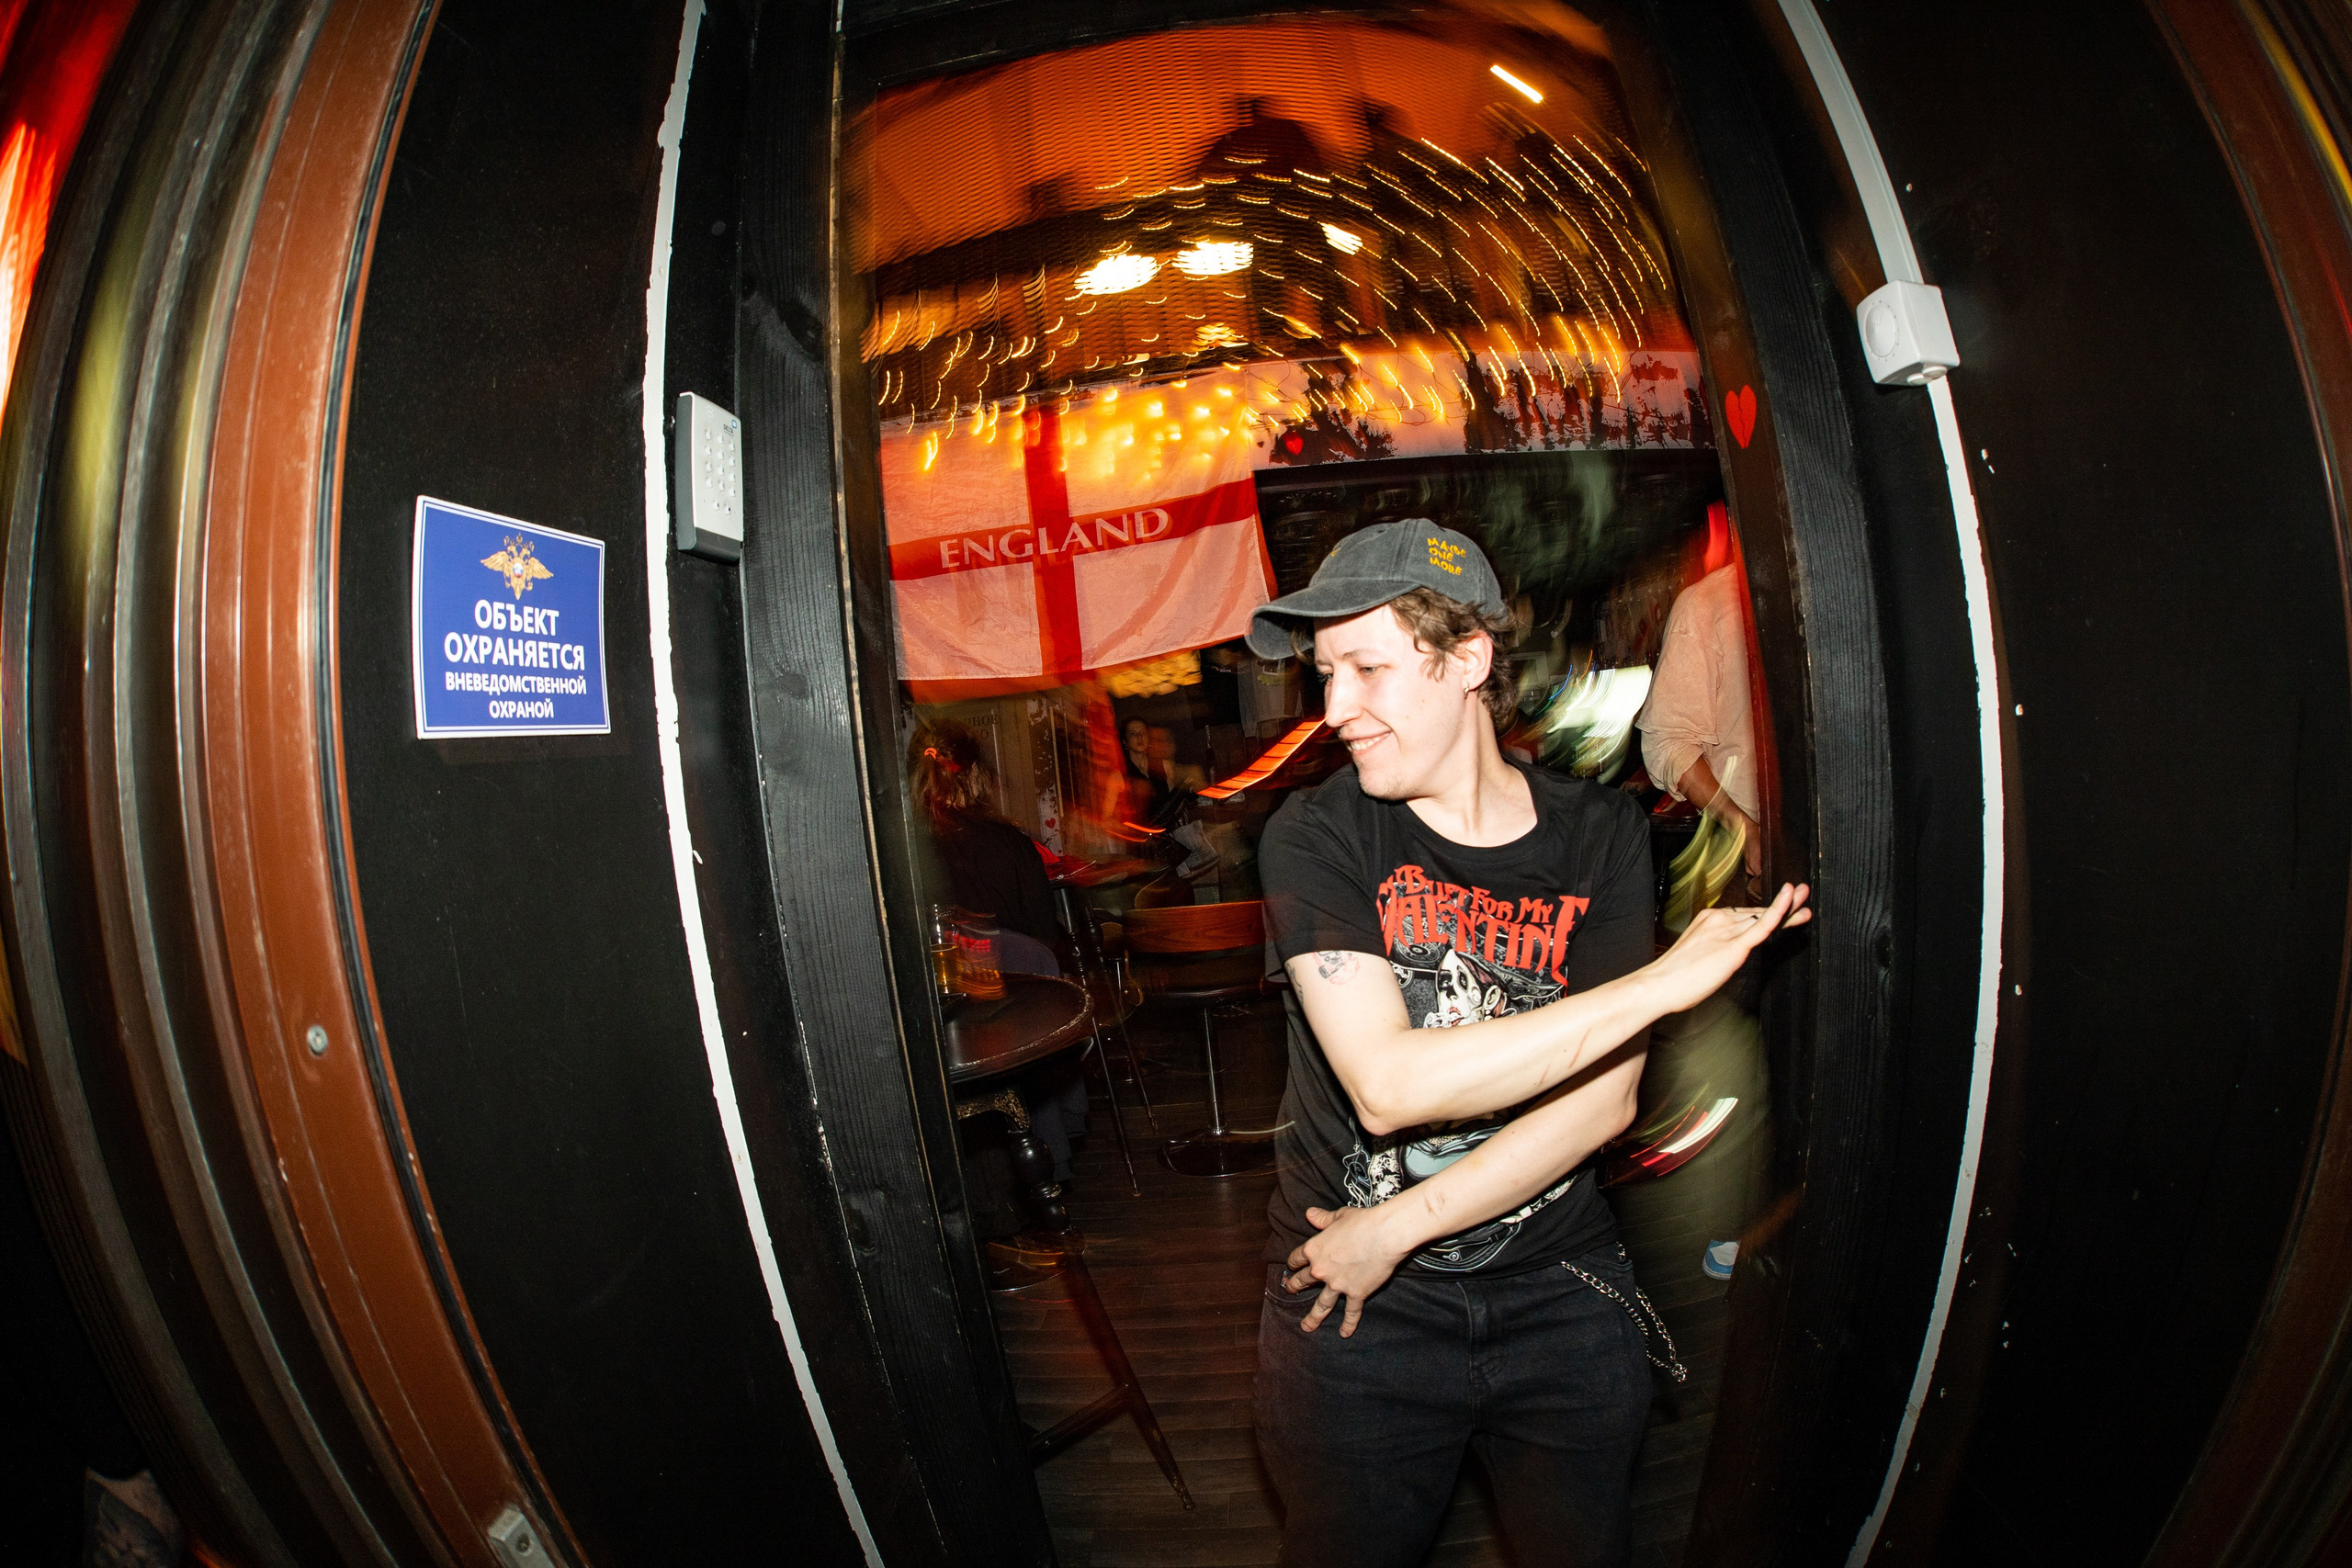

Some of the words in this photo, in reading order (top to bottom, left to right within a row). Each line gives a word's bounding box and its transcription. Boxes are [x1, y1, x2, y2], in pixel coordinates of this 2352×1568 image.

[940, 508, 1170, 569] ENGLAND
[1427, 537, 1466, 558] MAYBE
[1429, 547, 1453, 561] ONE
[1430, 557, 1463, 576] MORE
[474, 600, 560, 636] ОБЪЕКТ
[444, 632, 585, 671] ОХРАНЯЕТСЯ
[445, 671, 586, 695] ВНЕВЕДОМСТВЕННОЙ
[489, 697, 554, 718] ОХРАНОЙ
[1394, 863, 1470, 908] BULT
[1470, 886, 1515, 921] FOR
[1514, 897, 1555, 923] MY
